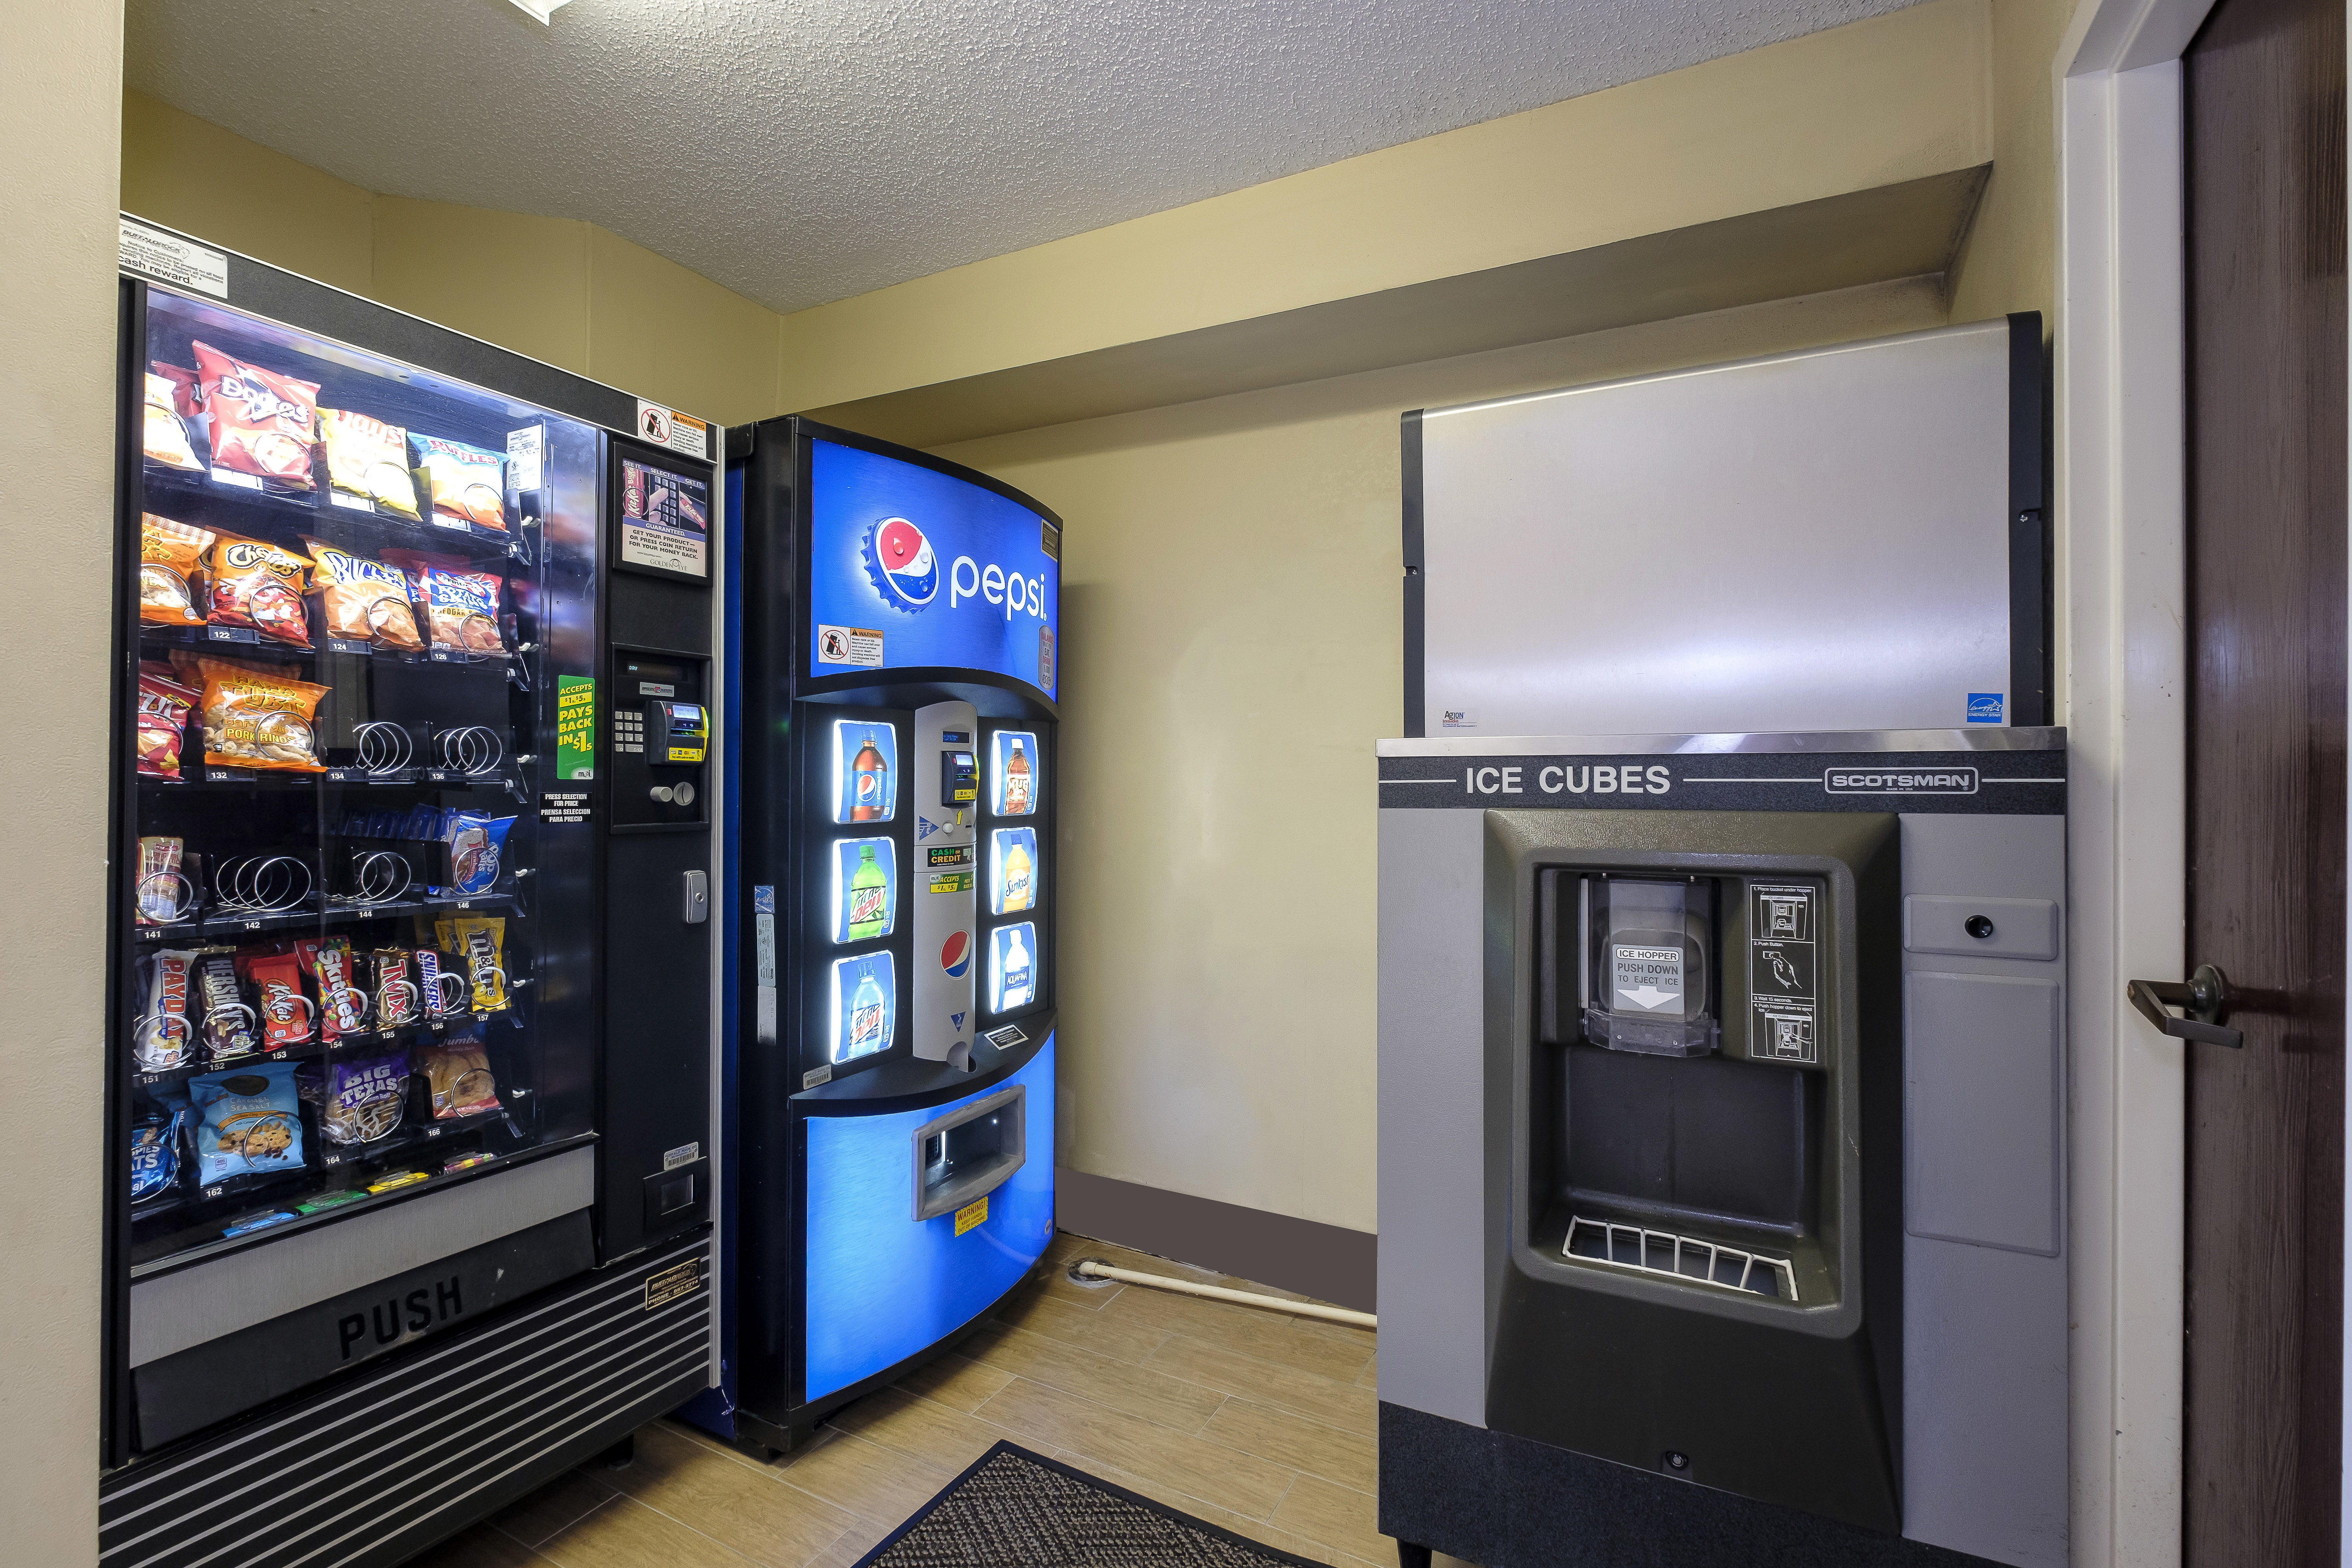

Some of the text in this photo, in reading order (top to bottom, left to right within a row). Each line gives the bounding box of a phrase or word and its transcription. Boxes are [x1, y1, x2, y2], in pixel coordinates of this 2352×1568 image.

[119, 256, 193, 285] cash reward.
[679, 417, 705, 430] WARNING
[650, 468, 670, 477] SELECT
[646, 523, 685, 536] GUARANTEED.
[675, 545, 697, 554] RETURN
[951, 556, 1044, 621] pepsi
[560, 683, 593, 695] ACCEPTS
[559, 706, 593, 722] PAYS
[559, 717, 592, 733] BACK
[226, 728, 255, 741] PORK
[559, 734, 573, 746] IN
[1466, 766, 1670, 794] ICE CUBES
[1833, 775, 1969, 786] SCOTSMAN
[931, 855, 960, 863] CREDIT
[1638, 951, 1677, 960] HOPPER
[1618, 963, 1678, 975] PUSH DOWN
[1007, 971, 1027, 986] AQUAFINA
[1634, 976, 1659, 984] EJECT
[143, 1075, 158, 1083] 151
[345, 1065, 391, 1089] BIG
[341, 1078, 397, 1105] TEXAS
[326, 1156, 340, 1164] 164
[206, 1188, 222, 1196] 162
[958, 1200, 985, 1222] WARNING!
[649, 1293, 669, 1304] PHONE
[338, 1276, 462, 1361] PUSH
